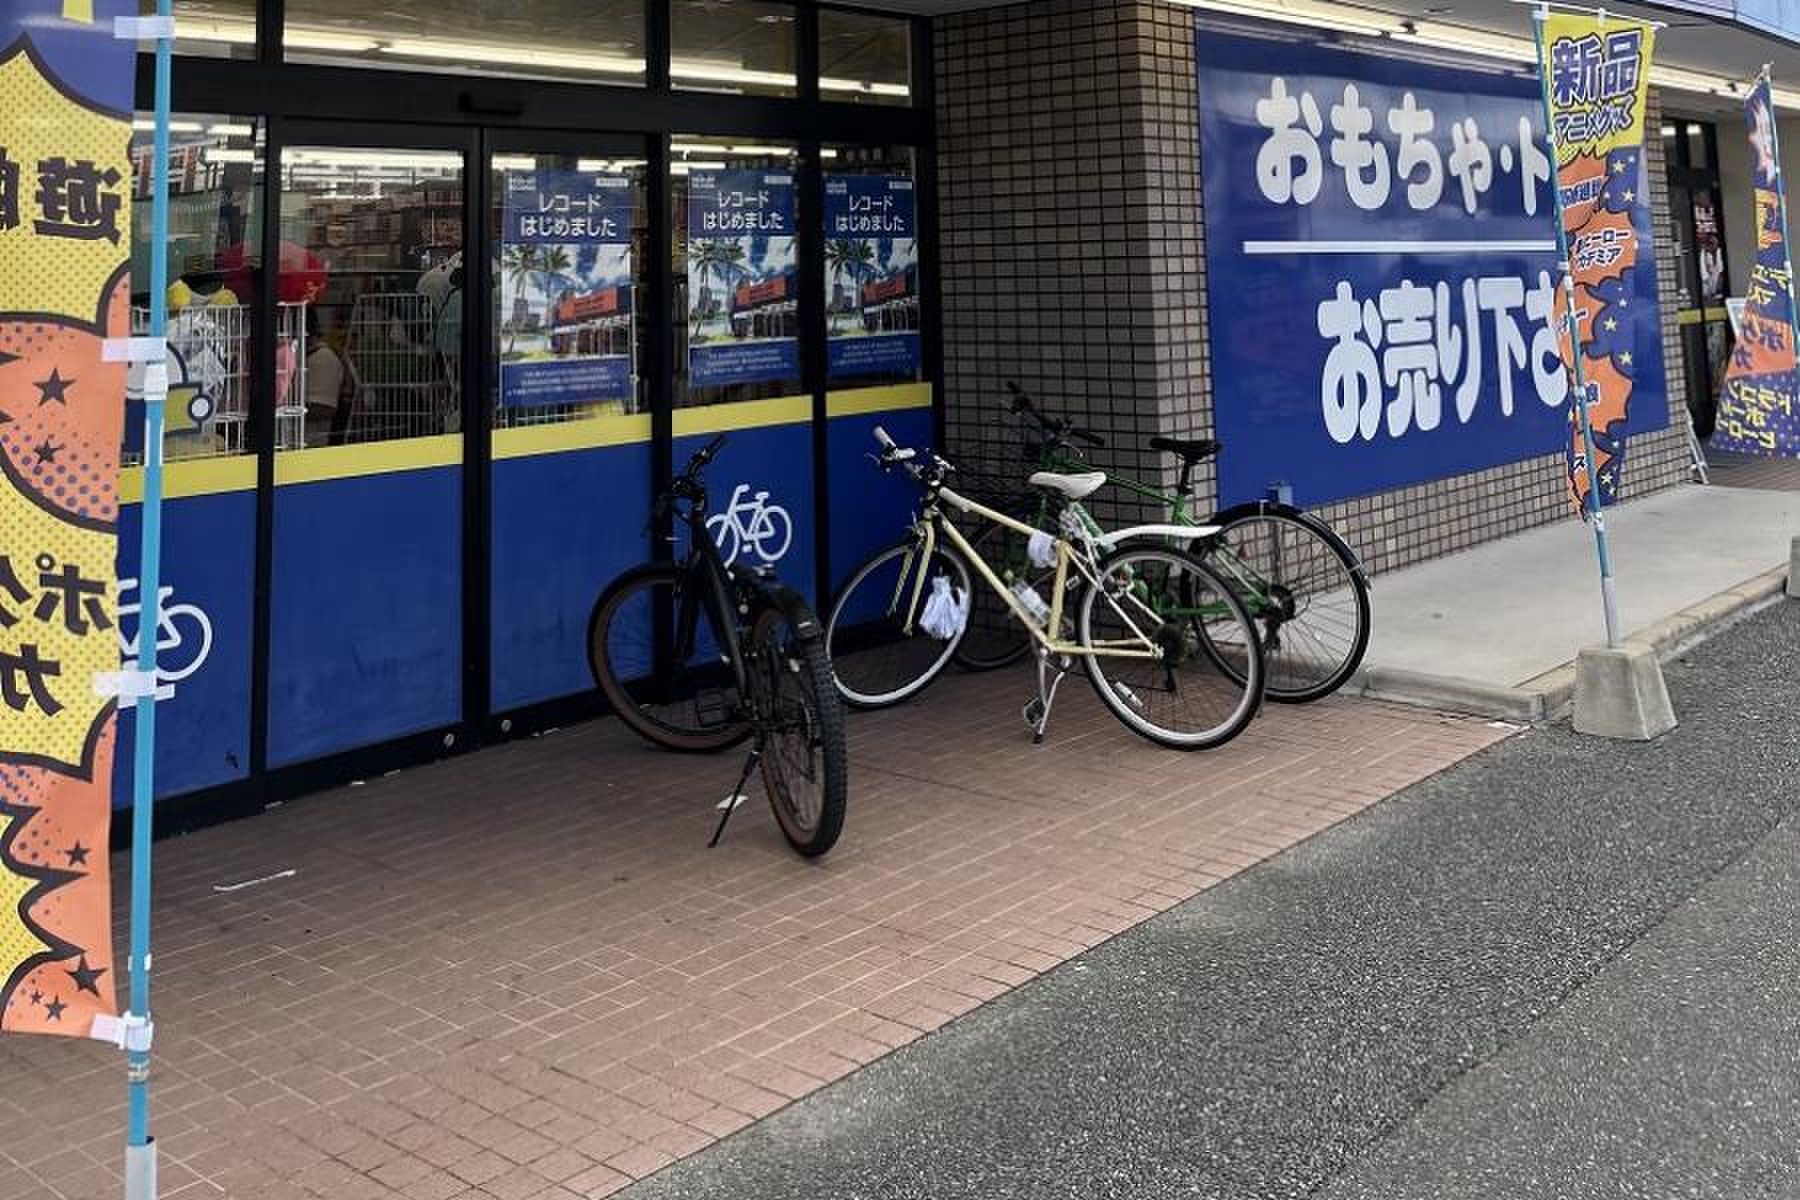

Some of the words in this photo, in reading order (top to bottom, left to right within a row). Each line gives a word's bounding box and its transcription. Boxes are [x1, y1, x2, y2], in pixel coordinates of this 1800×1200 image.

[1551, 29, 1642, 107] 新品
[538, 192, 602, 213] レコード
[717, 189, 769, 209] レコード
[848, 194, 894, 212] レコード
[519, 215, 617, 237] はじめました
[703, 211, 785, 231] はじめました
[835, 214, 905, 232] はじめました
